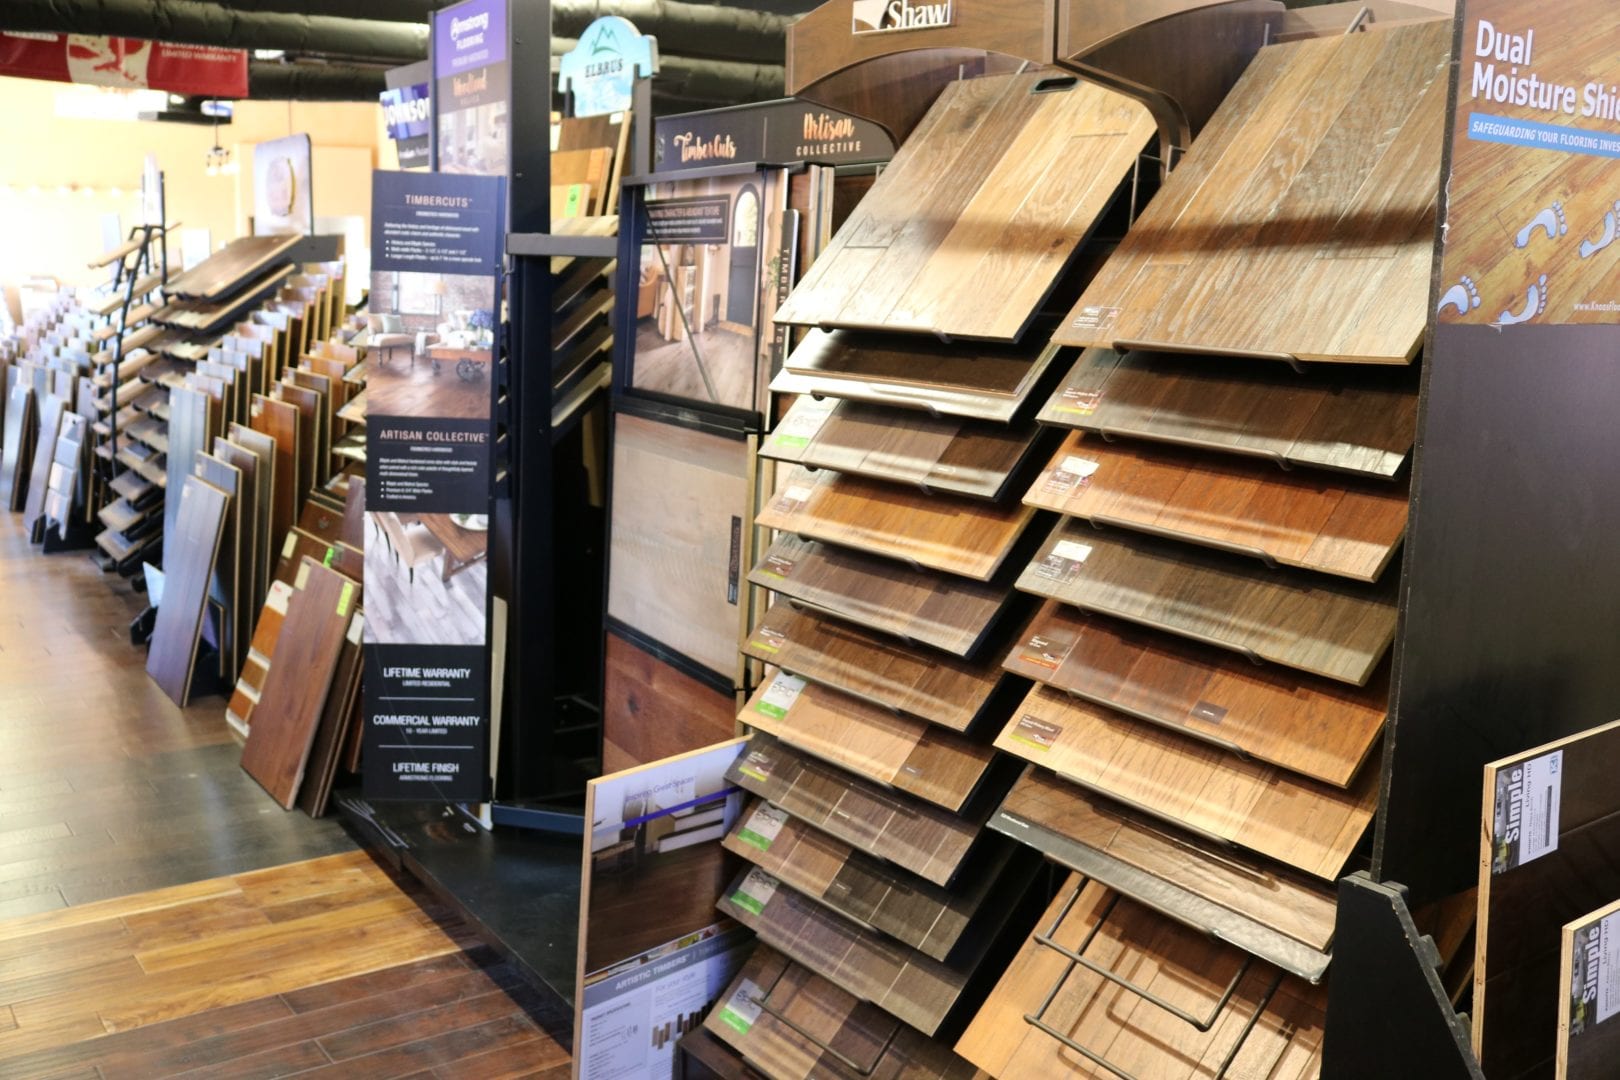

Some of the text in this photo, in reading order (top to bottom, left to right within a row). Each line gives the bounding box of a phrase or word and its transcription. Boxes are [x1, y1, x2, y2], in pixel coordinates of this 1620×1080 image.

[886, 0, 947, 29] Shaw
[1475, 19, 1534, 66] Dual
[585, 58, 623, 78] ELBRUS
[1471, 61, 1577, 115] Moisture
[803, 113, 855, 141] Artisan
[1472, 121, 1536, 140] SAFEGUARDING
[1537, 130, 1558, 144] YOUR
[1560, 134, 1598, 150] FLOORING
[796, 141, 862, 157] COLLECTIVE
[380, 429, 423, 441] ARTISAN
[384, 667, 471, 679] LIFETIME WARRANTY
[373, 715, 480, 727] COMMERCIAL WARRANTY
[393, 762, 460, 774] LIFETIME FINISH
[1505, 769, 1524, 844] Simple
[1583, 926, 1601, 1004] Simple
[615, 970, 651, 991] ARTISTIC
